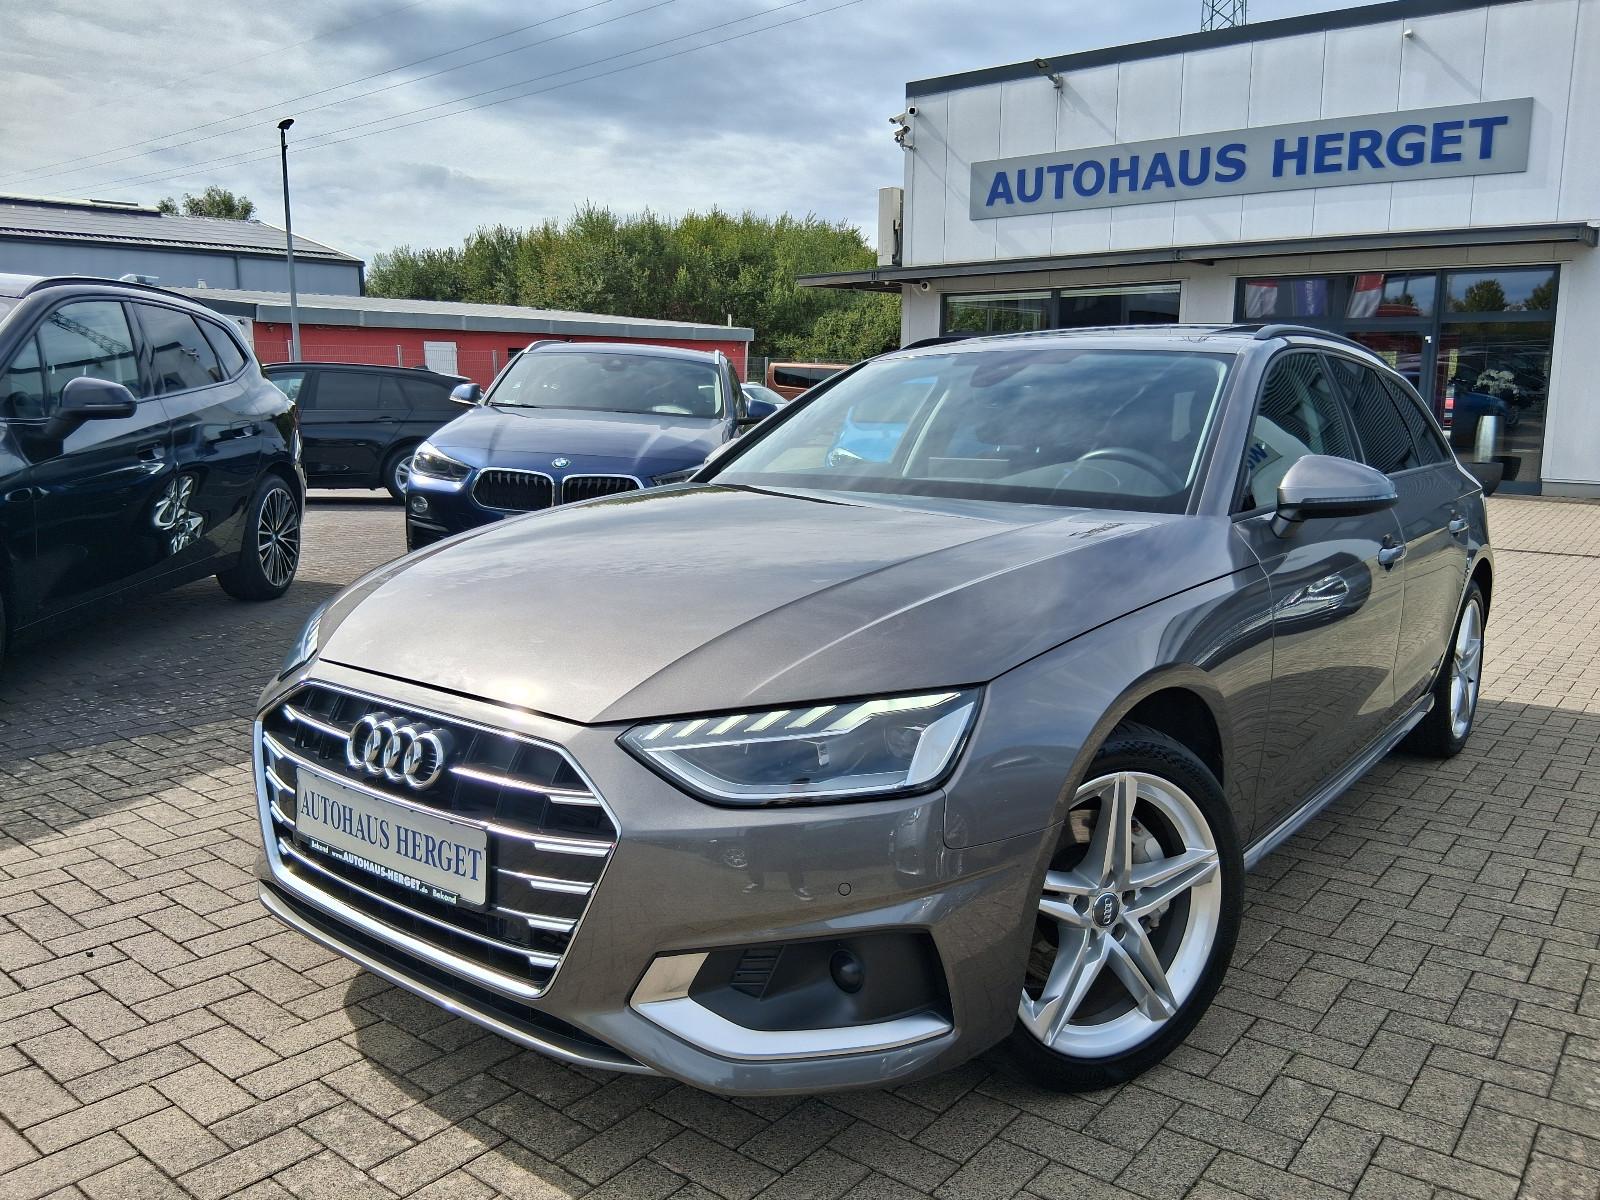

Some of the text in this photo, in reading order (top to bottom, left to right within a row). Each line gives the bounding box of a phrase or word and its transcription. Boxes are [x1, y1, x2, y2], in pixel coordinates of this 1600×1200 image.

[986, 116, 1509, 207] AUTOHAUS HERGET
[301, 788, 483, 881] AUTOHAUS HERGET
[432, 888, 457, 904] Bekond
